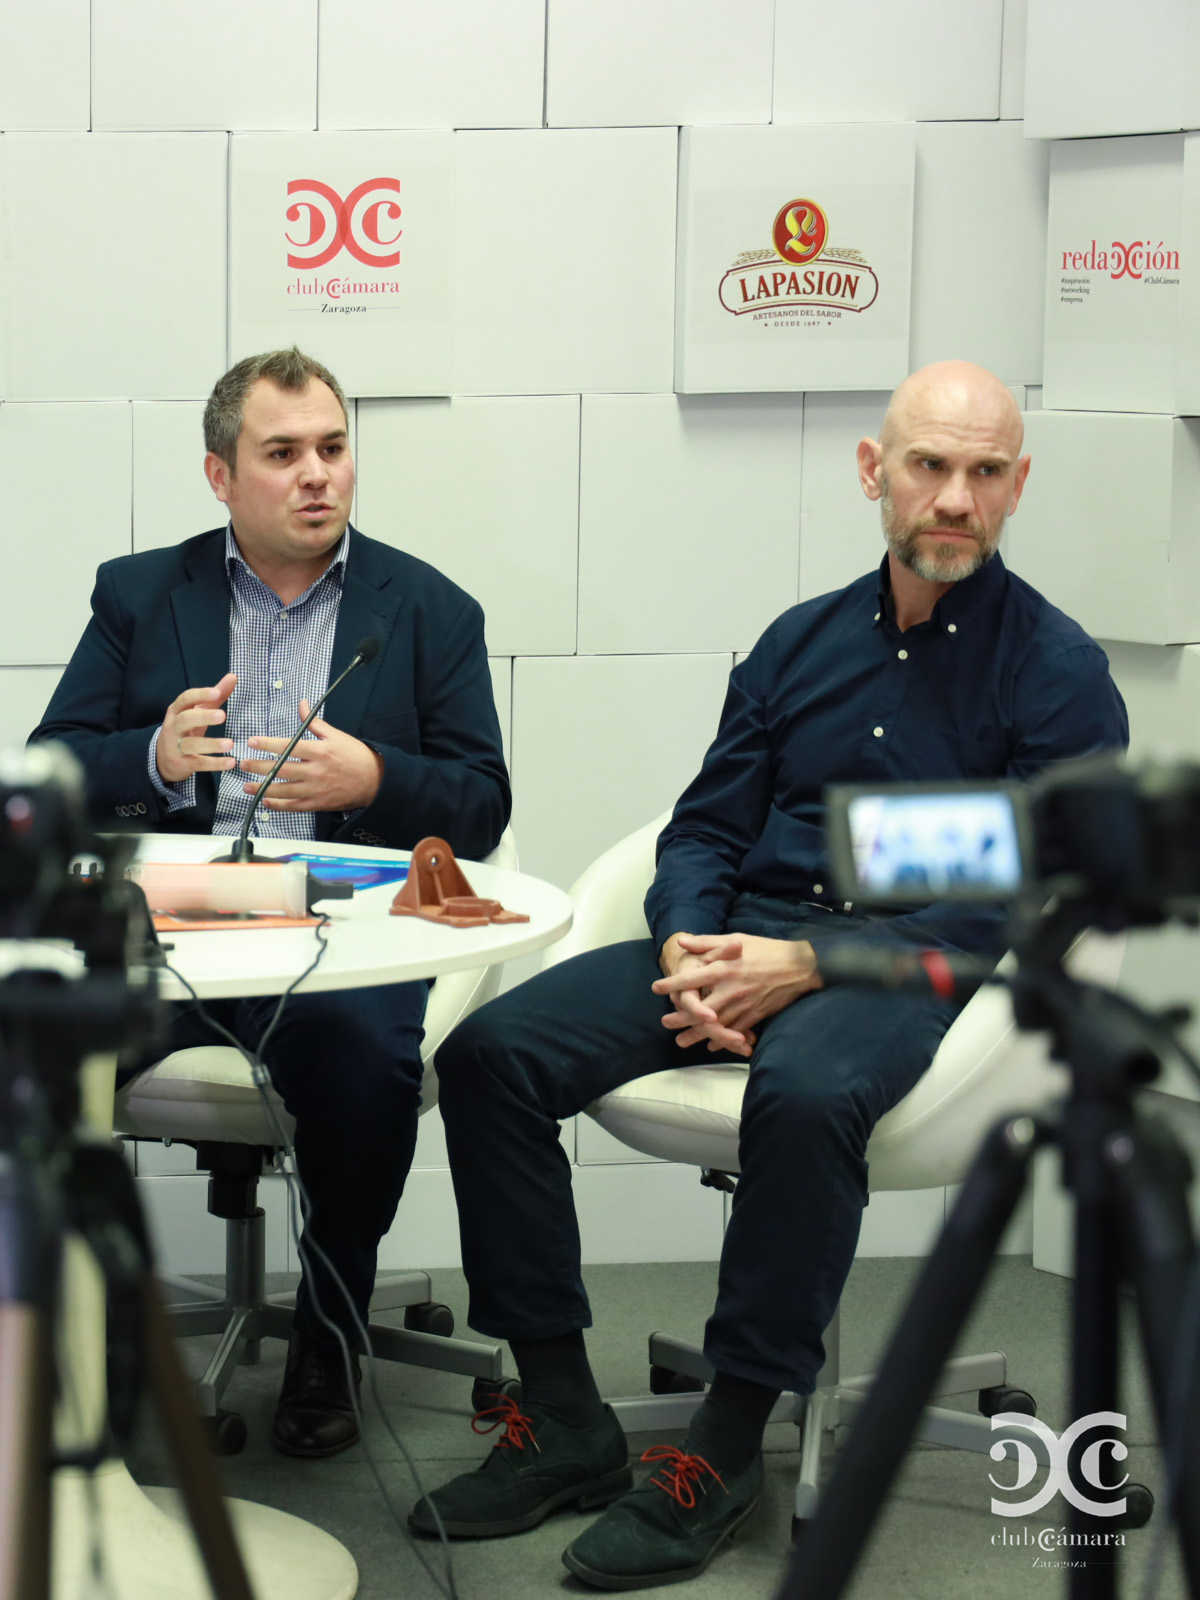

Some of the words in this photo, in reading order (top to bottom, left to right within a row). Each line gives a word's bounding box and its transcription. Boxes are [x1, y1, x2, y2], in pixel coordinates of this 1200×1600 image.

[739, 271, 860, 303] LAPASION
[321, 303, 367, 315] Zaragoza
[752, 310, 799, 321] ARTESANOS
[800, 309, 815, 317] DEL
[816, 310, 842, 319] SABOR
